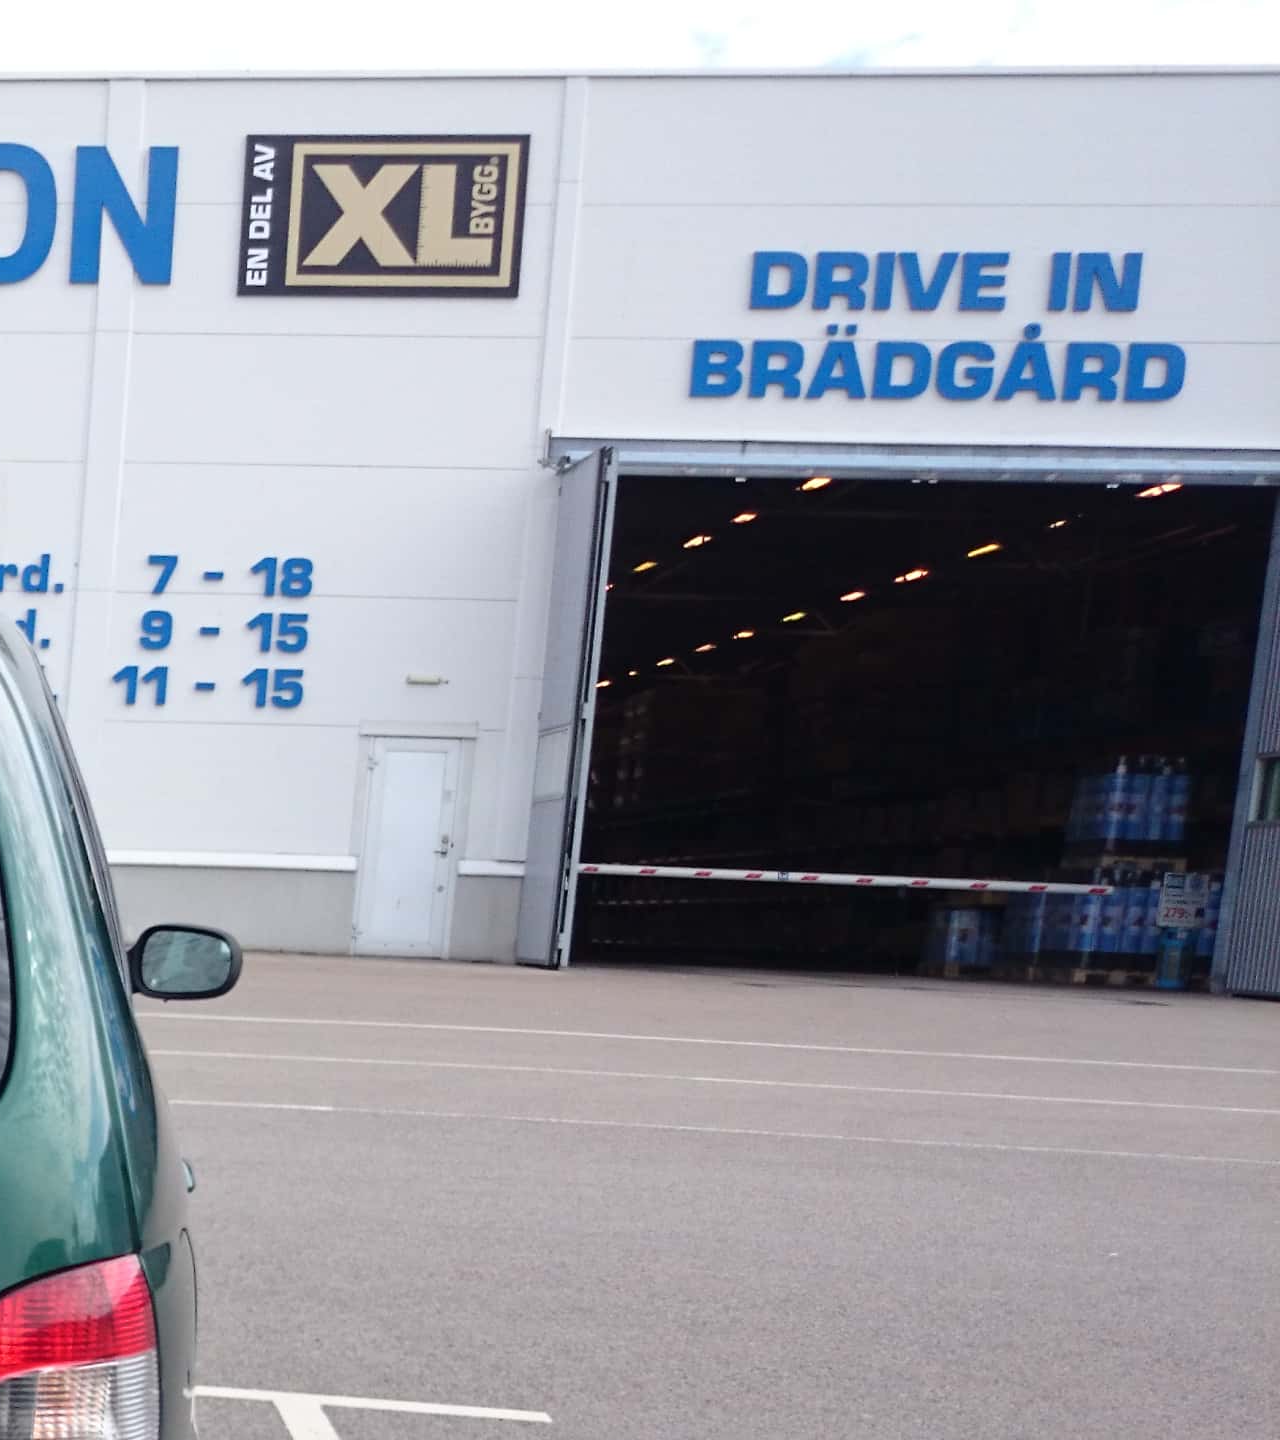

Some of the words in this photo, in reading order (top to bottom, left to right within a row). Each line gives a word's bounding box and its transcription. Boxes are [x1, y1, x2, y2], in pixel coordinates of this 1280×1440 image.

[254, 144, 276, 181] AV
[248, 187, 273, 240] DEL
[302, 164, 494, 268] XL
[246, 248, 269, 286] EN
[749, 250, 1010, 312] DRIVE
[1047, 252, 1143, 313] IN
[689, 323, 1186, 402] BRÄDGÅRD
[147, 555, 178, 595] 7
[203, 570, 224, 581] -
[251, 557, 314, 598] 18
[139, 609, 173, 651] 9
[199, 626, 220, 637] -
[246, 612, 309, 654] 15
[112, 666, 169, 706] 11
[194, 681, 215, 692] -
[241, 668, 304, 709] 15
